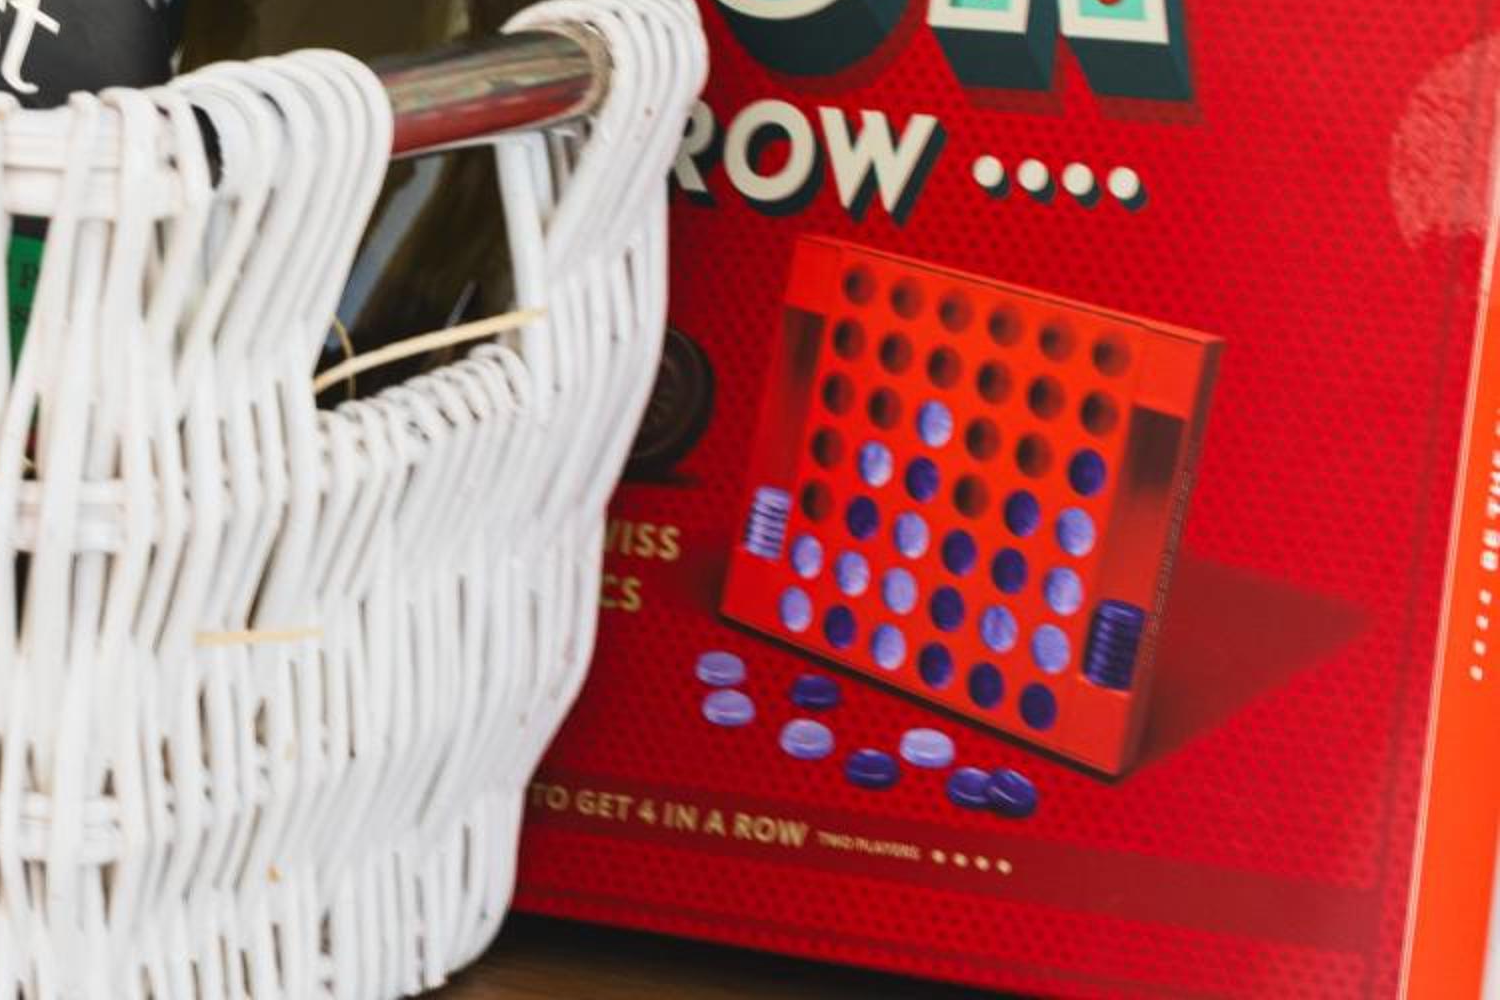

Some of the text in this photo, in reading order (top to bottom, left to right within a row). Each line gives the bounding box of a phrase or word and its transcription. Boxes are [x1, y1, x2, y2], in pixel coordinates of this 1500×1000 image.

[532, 782, 809, 849] TO GET 4 IN A ROW
